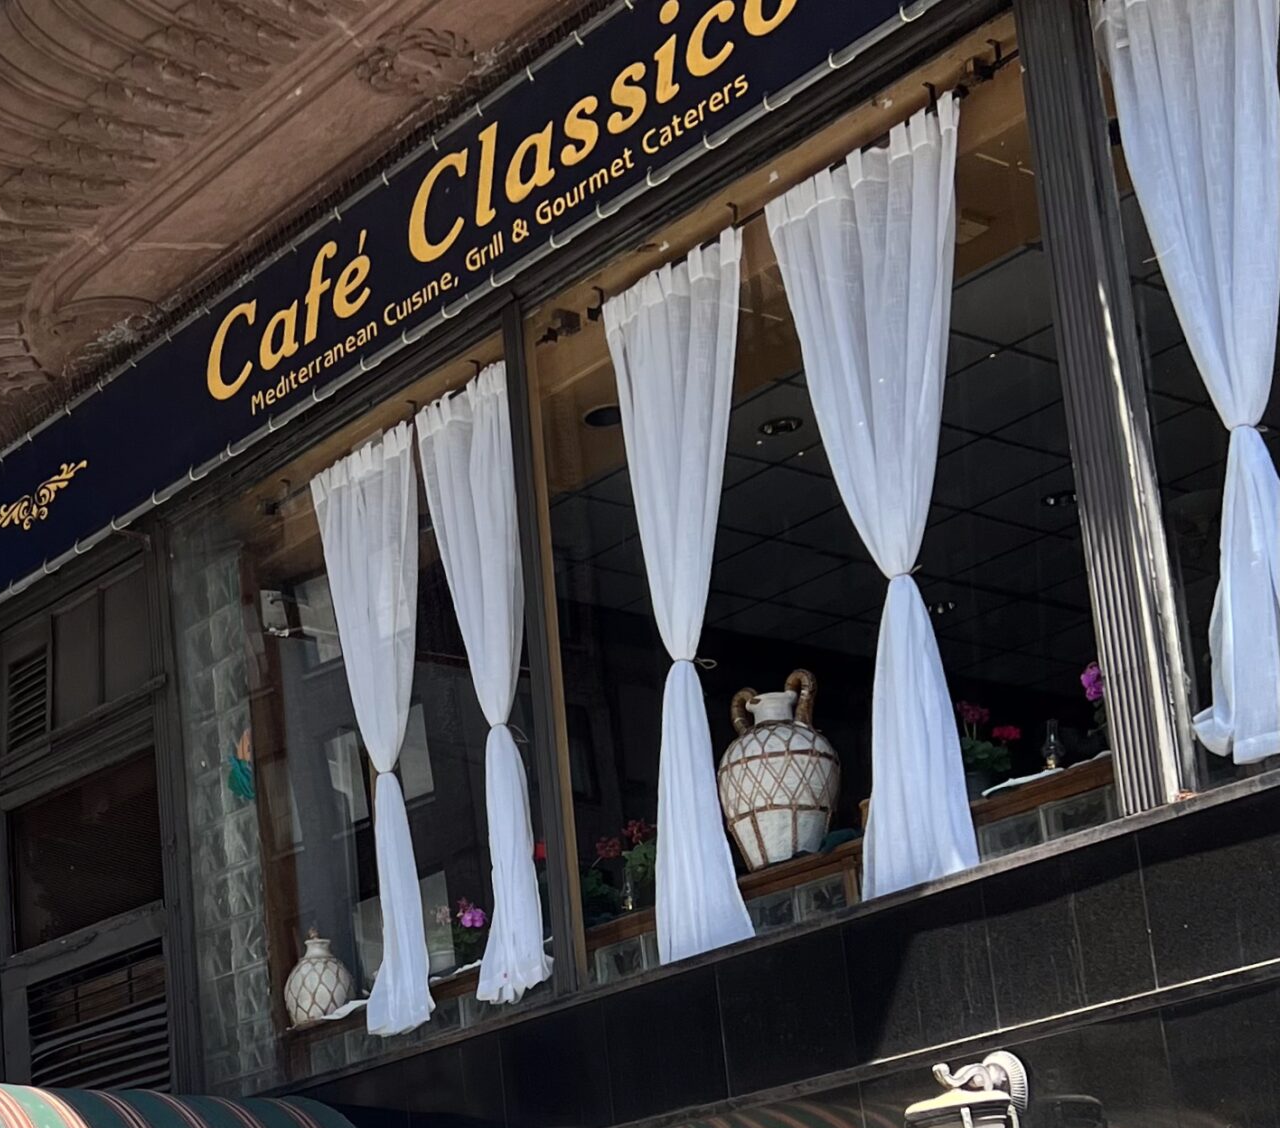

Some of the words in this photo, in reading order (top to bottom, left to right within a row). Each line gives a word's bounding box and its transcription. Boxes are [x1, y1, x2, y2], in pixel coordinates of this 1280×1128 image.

[206, 228, 371, 400] Café
[250, 320, 379, 416] Mediterranean
[383, 271, 459, 327] Cuisine,
[464, 230, 504, 273] Grill
[511, 218, 530, 244] &
[534, 146, 635, 226] Gourmet
[641, 73, 750, 155] Caterers
